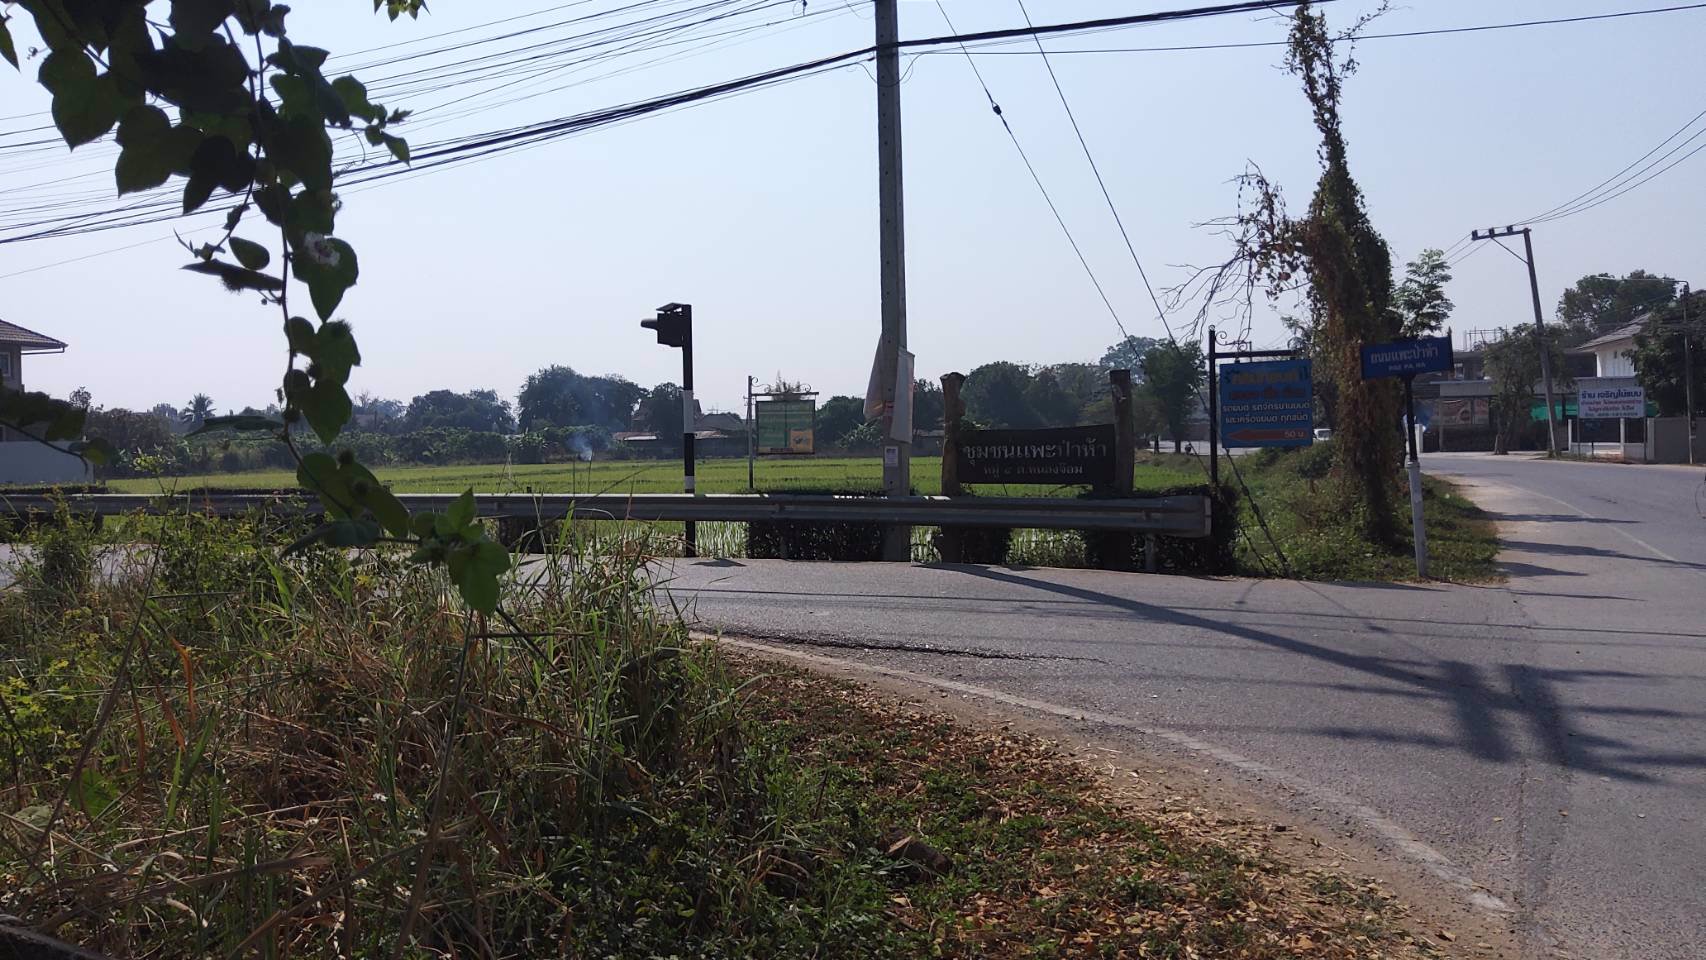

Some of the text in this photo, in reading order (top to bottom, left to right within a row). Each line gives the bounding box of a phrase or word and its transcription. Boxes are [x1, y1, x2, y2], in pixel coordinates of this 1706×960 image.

[963, 438, 1106, 466] ชุมชนแพะป่าห้า
